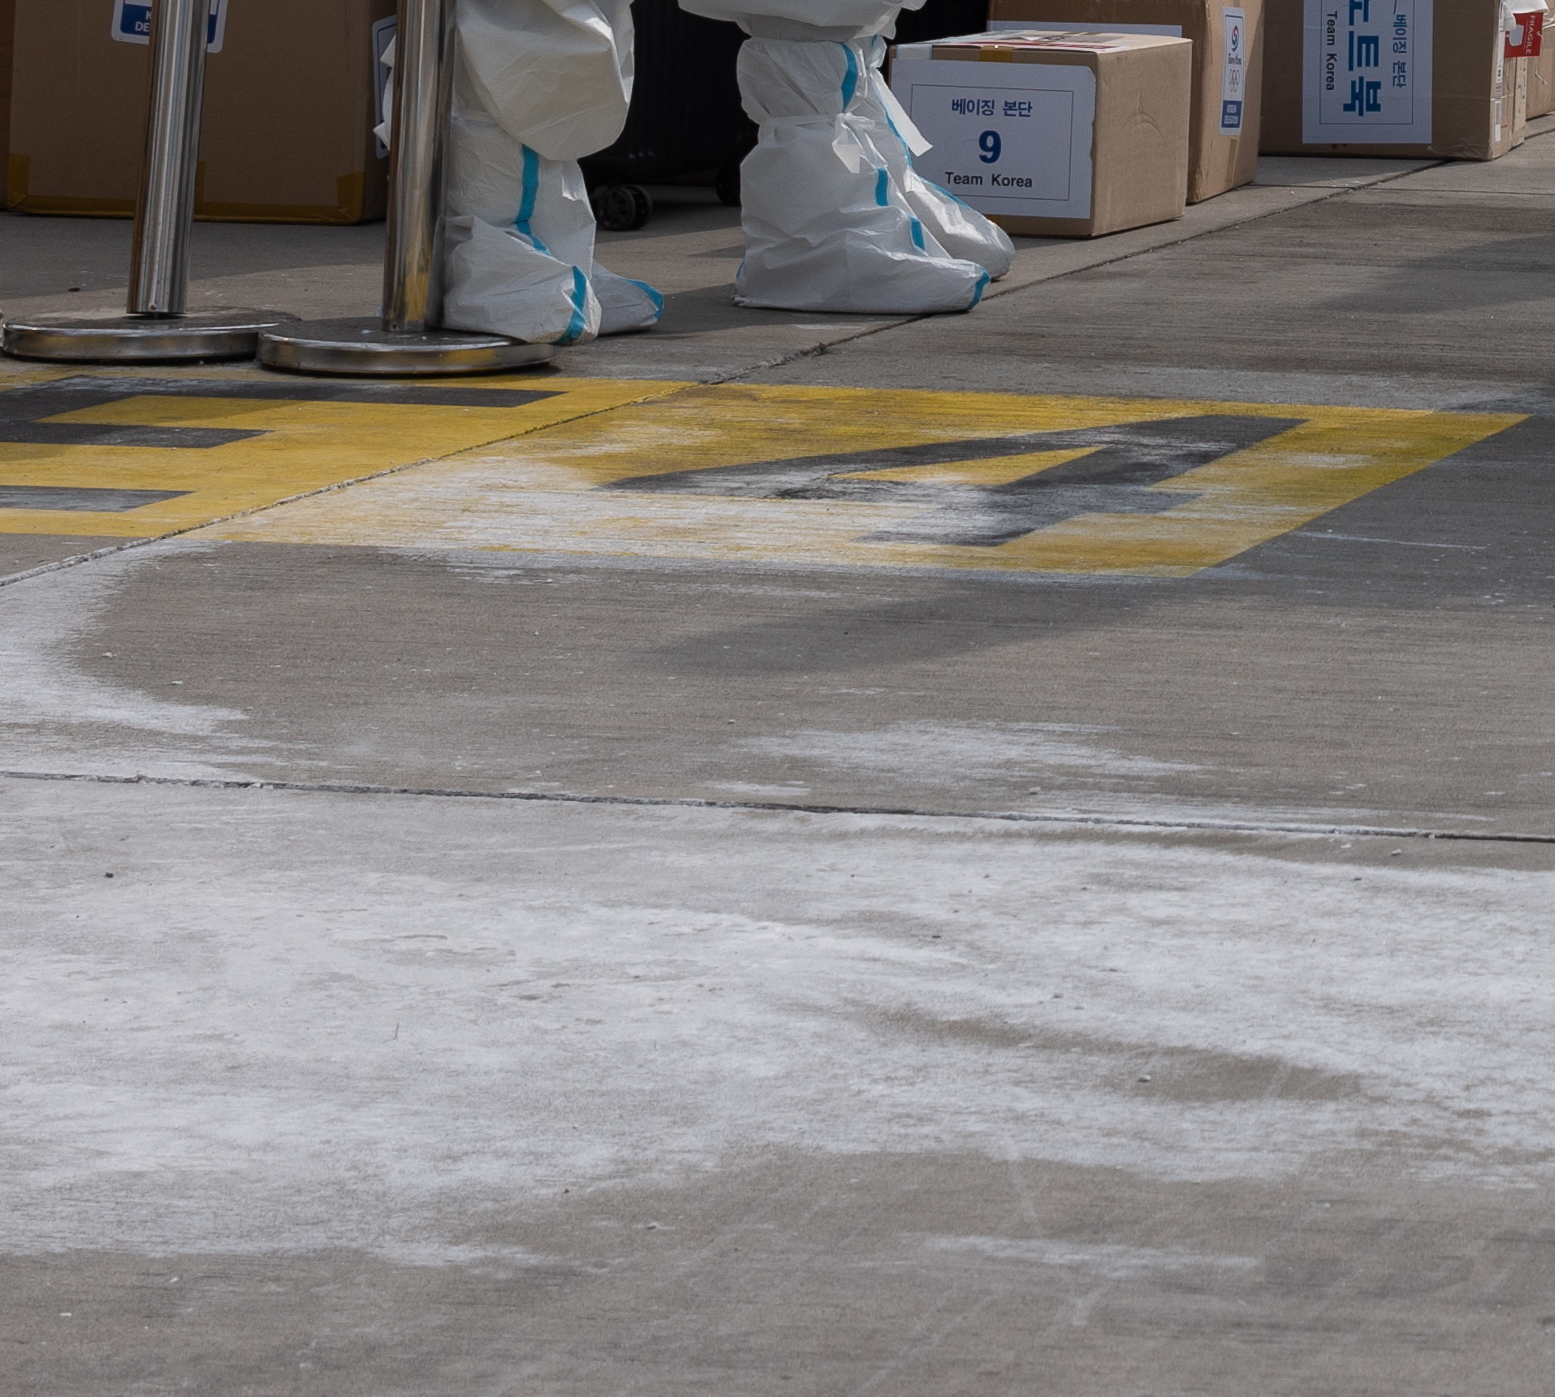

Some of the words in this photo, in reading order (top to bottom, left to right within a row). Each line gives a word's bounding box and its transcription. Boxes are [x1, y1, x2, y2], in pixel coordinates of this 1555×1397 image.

[1325, 10, 1338, 46] Team
[1393, 13, 1407, 54] 베이징
[1525, 15, 1537, 55] FRAGILE
[1325, 52, 1338, 91] Korea
[1393, 60, 1407, 89] 본단
[951, 98, 995, 116] 베이징
[1002, 100, 1033, 118] 본단
[978, 130, 1002, 164] 9
[945, 172, 983, 186] Team
[991, 174, 1033, 189] Korea
